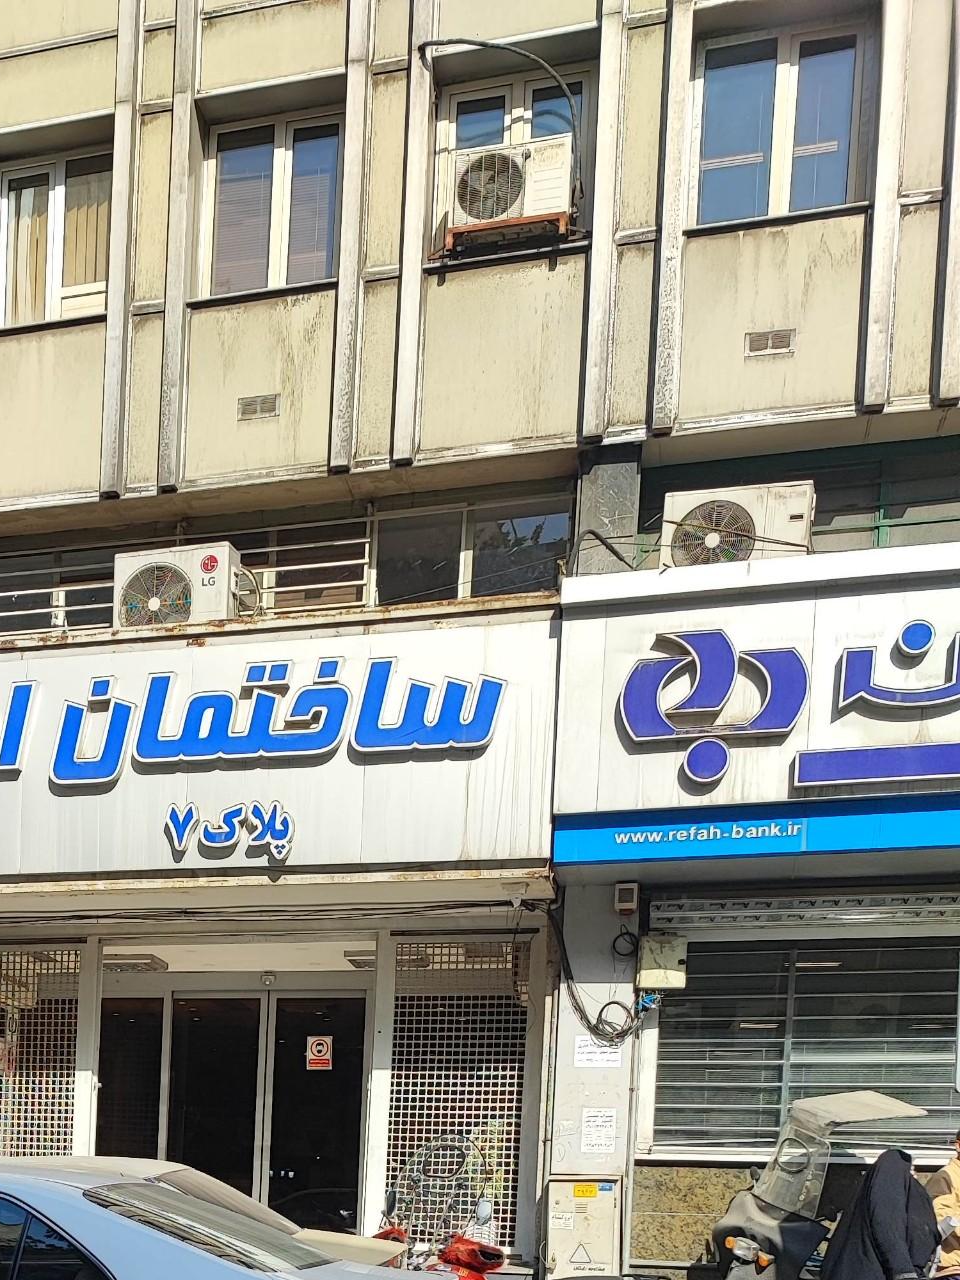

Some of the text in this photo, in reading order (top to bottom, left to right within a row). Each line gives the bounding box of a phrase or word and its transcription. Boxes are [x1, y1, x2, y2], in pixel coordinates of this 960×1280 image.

[201, 576, 216, 587] LG
[48, 656, 507, 785] ساختمان
[165, 801, 295, 859] پلاک ۷
[614, 822, 802, 845] www.refah-bank.ir
